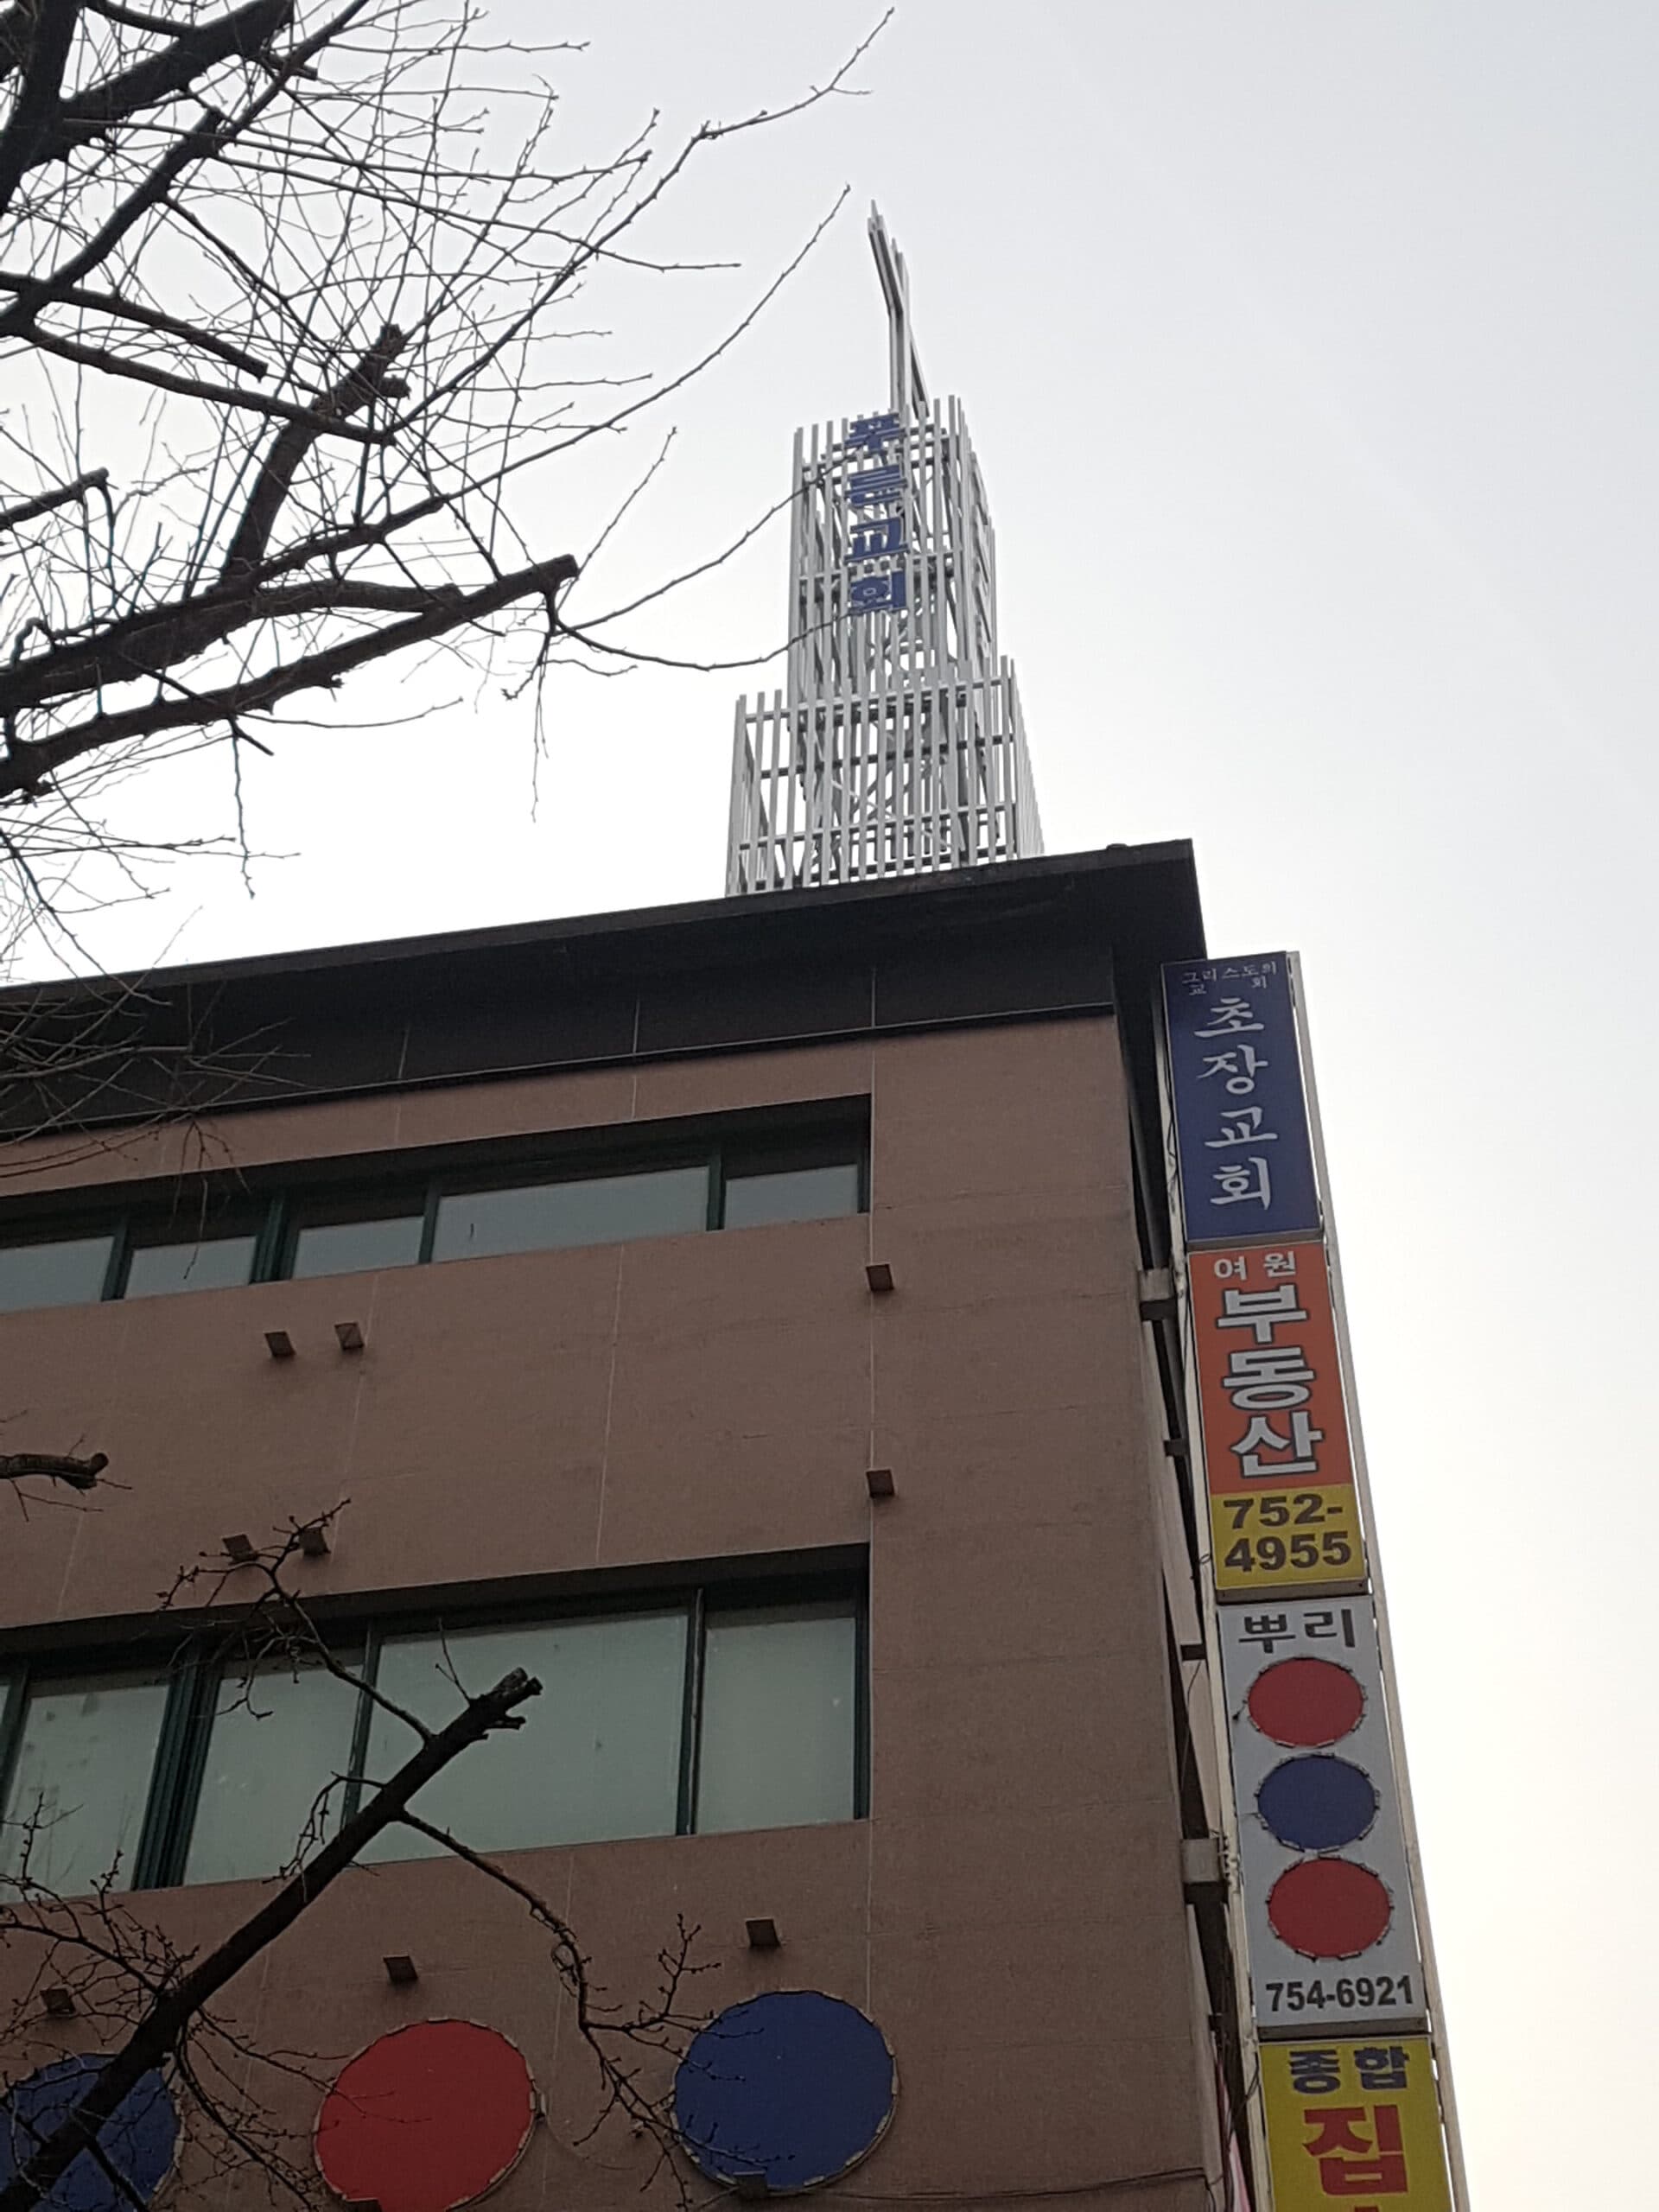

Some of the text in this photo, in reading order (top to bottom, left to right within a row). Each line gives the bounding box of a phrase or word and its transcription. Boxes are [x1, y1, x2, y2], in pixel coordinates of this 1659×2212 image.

[1192, 996, 1280, 1211] 초장교회
[1212, 1249, 1297, 1281] 여원
[1215, 1282, 1325, 1479] 부동산
[1223, 1492, 1344, 1530] 752-
[1224, 1530, 1352, 1573] 4955
[1237, 1607, 1356, 1654] 뿌리
[1265, 1974, 1414, 2012] 754-6921
[1288, 2045, 1410, 2094] 종합
[1302, 2104, 1409, 2212] 집
